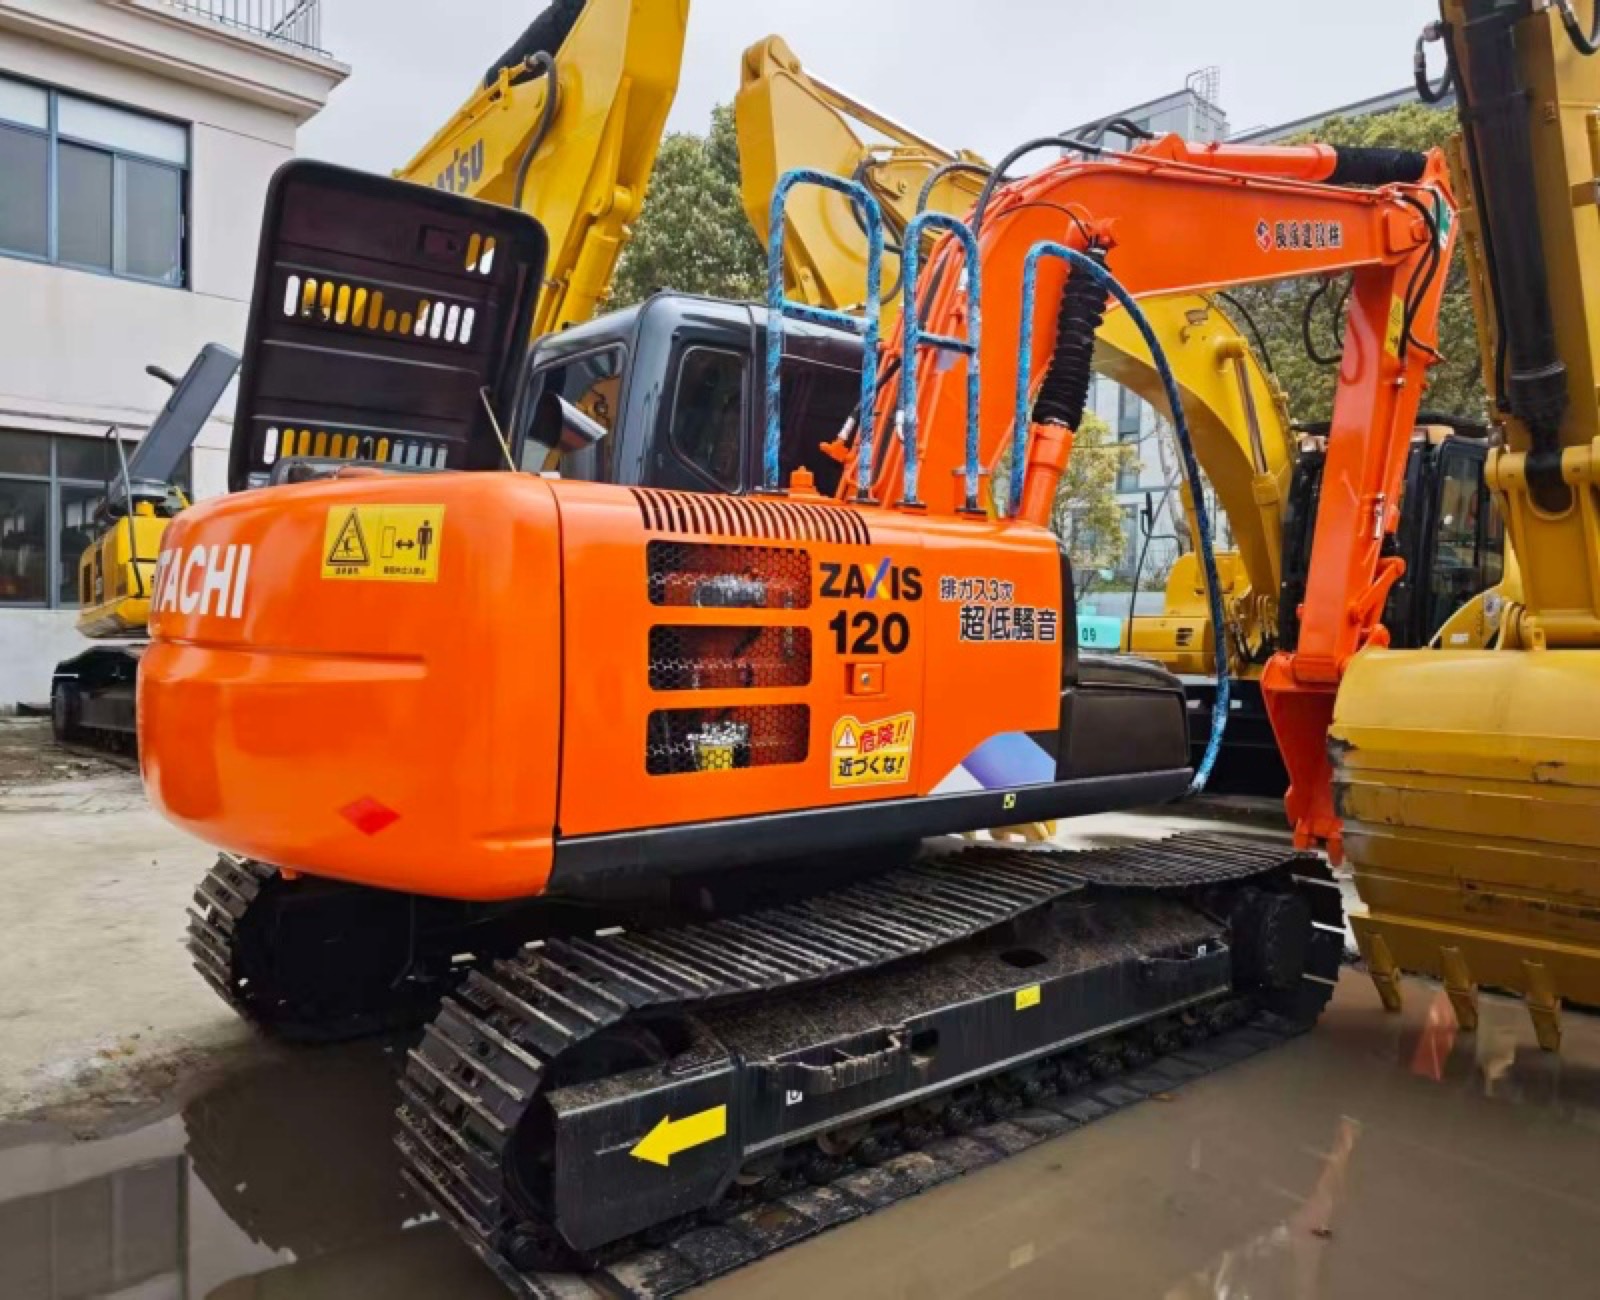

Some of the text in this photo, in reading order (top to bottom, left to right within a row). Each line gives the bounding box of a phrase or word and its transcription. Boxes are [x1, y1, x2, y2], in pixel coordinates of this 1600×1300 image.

[819, 557, 923, 601] ZAXIS
[829, 609, 910, 654] 120
[959, 605, 1057, 642] 超低騒音
